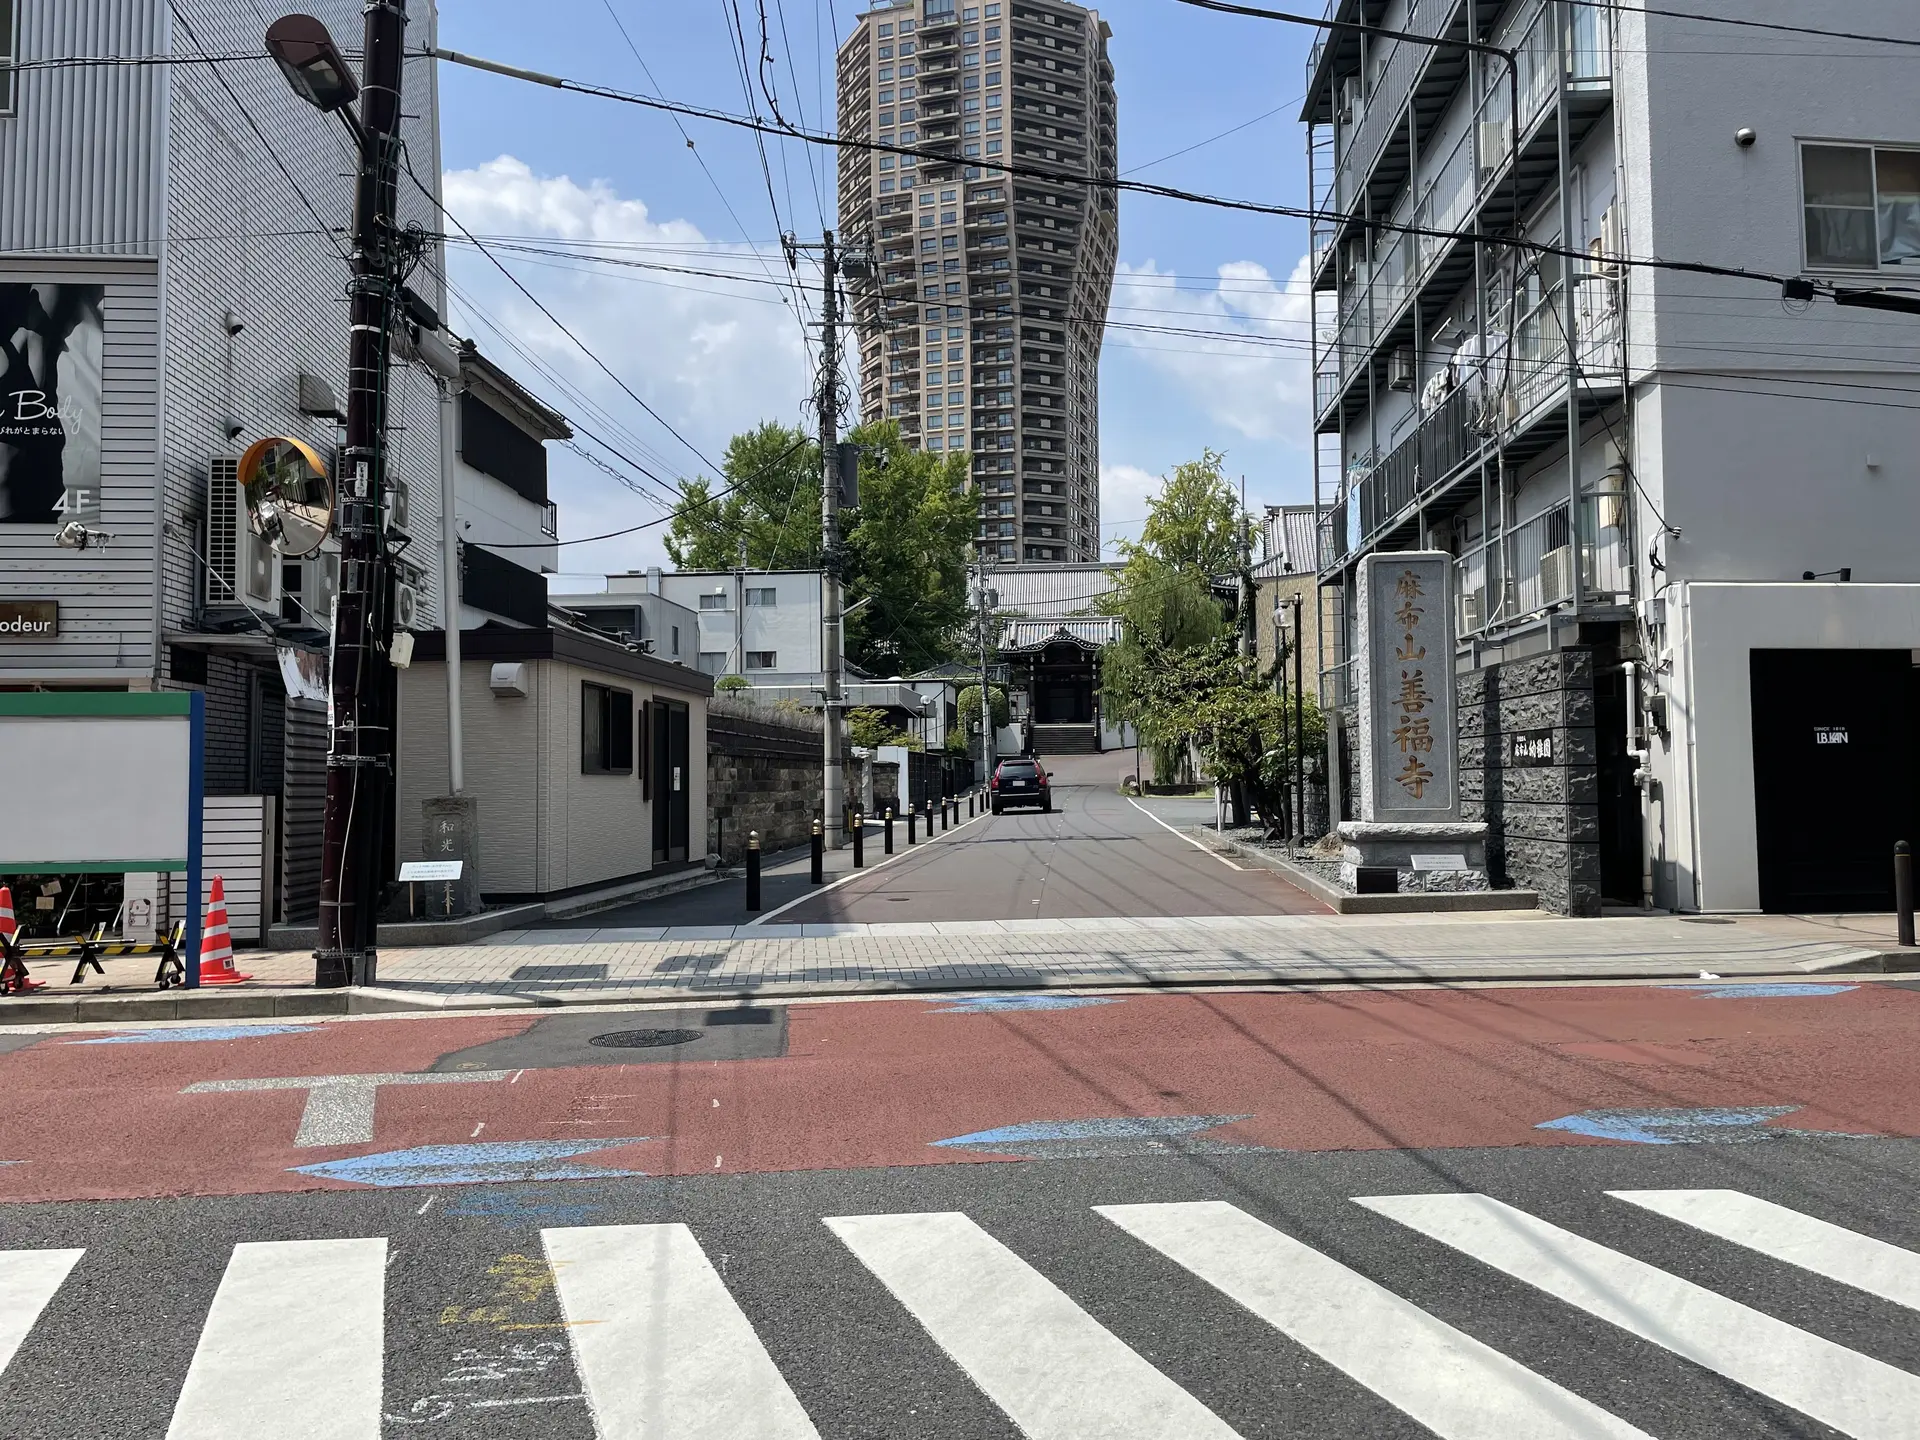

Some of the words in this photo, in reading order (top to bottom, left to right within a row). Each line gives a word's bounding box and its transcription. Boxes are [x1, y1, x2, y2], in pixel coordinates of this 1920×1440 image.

[9, 389, 83, 435] Body
[52, 488, 91, 514] 4F
[1391, 568, 1434, 800] 麻布山善福寺
